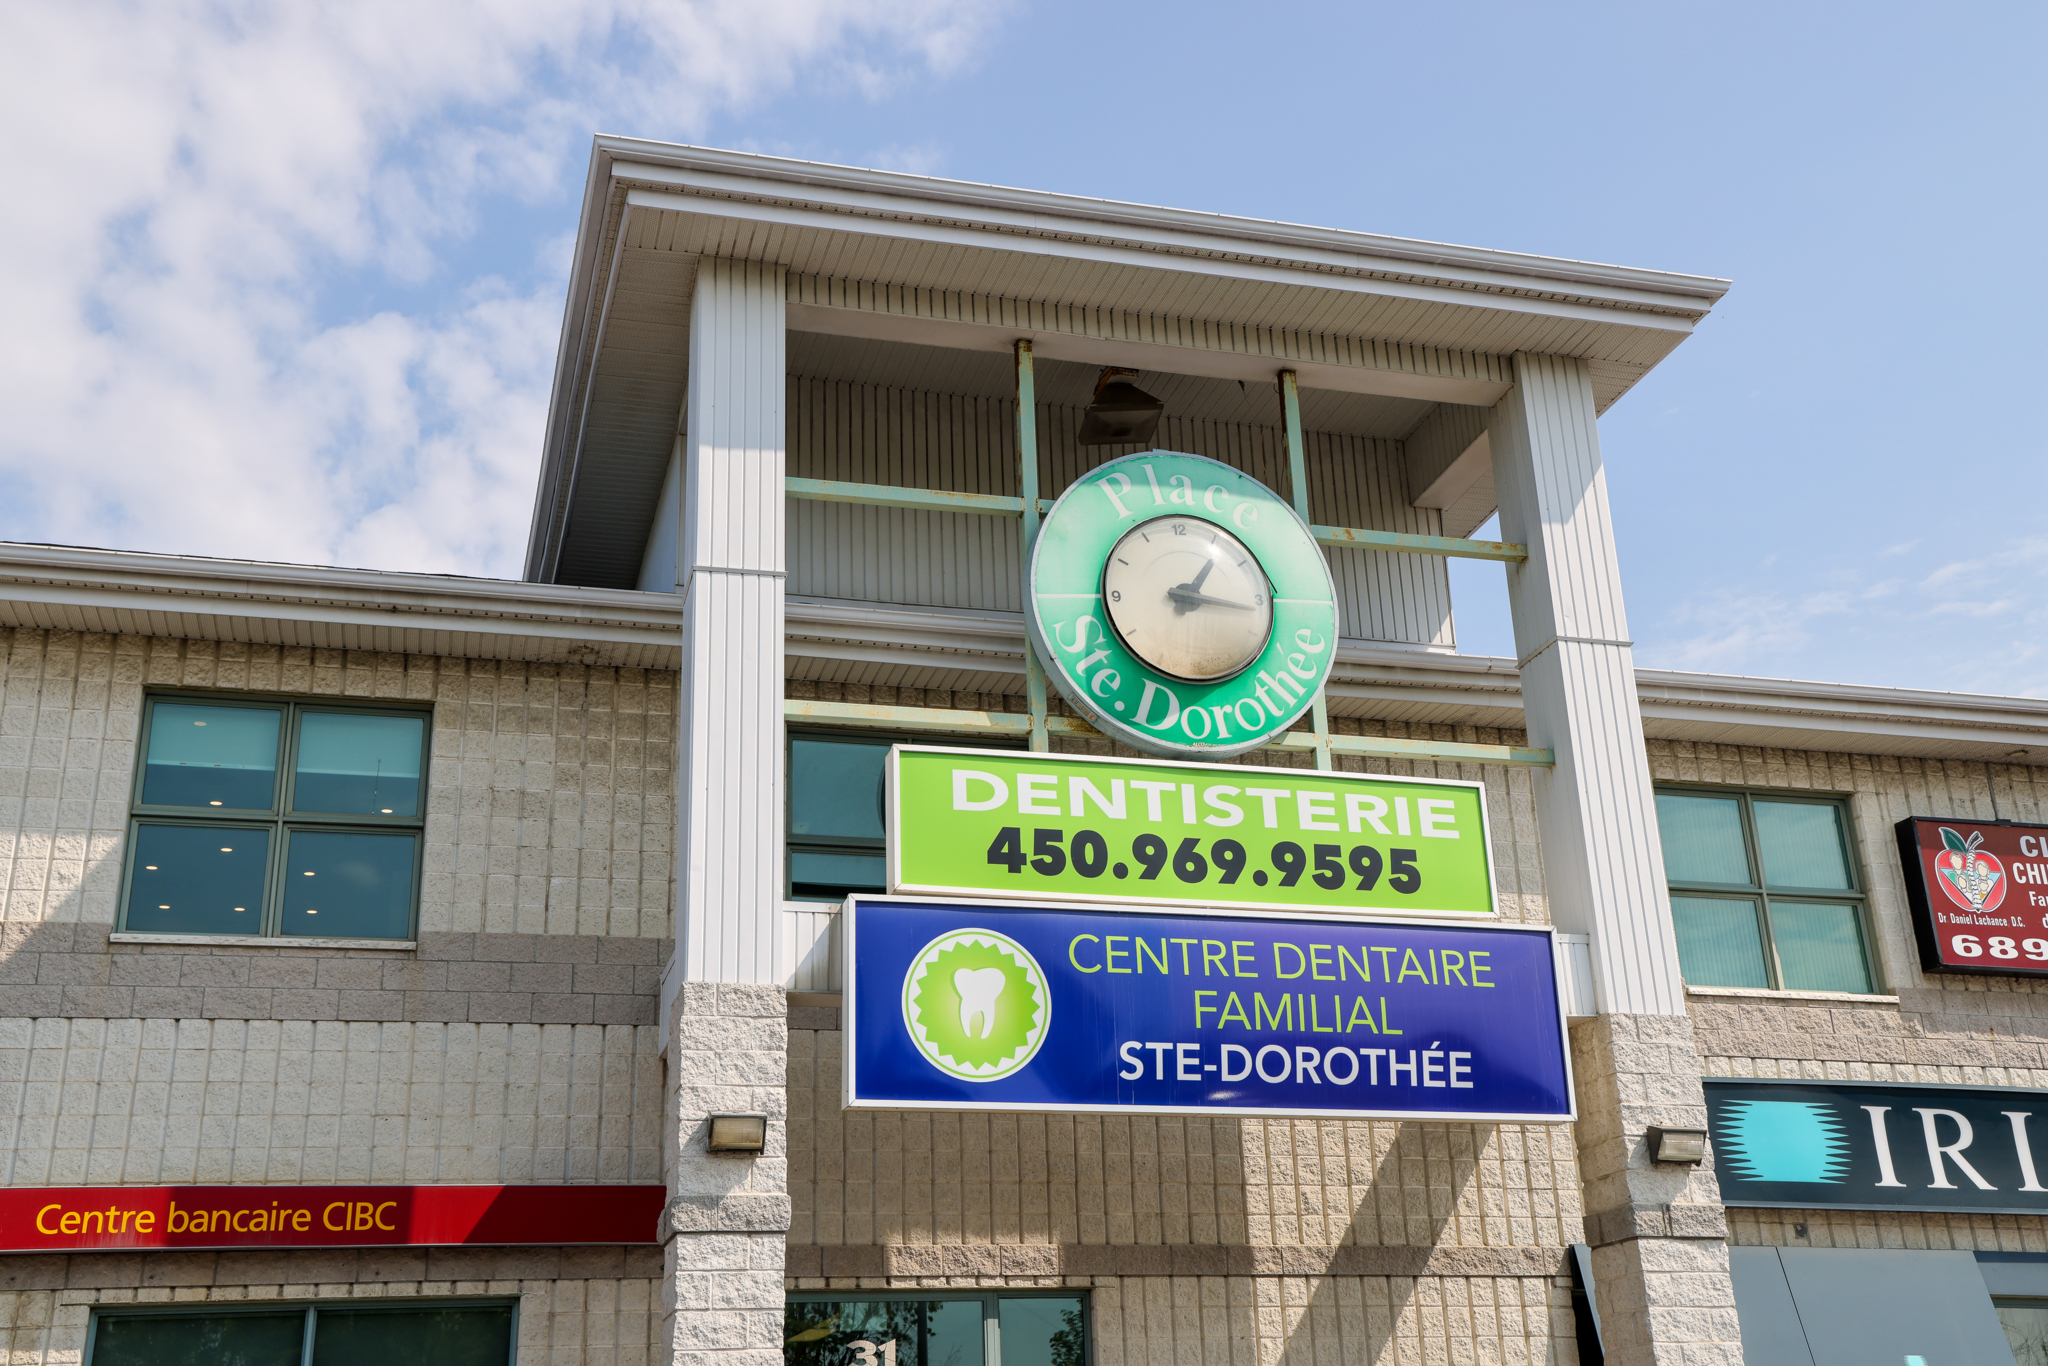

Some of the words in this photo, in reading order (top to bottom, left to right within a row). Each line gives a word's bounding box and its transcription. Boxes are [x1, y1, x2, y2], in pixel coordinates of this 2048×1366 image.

[1092, 463, 1259, 530] Place
[1170, 523, 1188, 536] 12
[1110, 590, 1122, 603] 9
[1253, 593, 1265, 606] 3
[951, 768, 1461, 840] DENTISTERIE
[987, 826, 1422, 895] 450.969.9595
[2012, 862, 2048, 885] CHI
[2028, 890, 2048, 907] Fa
[1949, 912, 1973, 925] Daniel
[1973, 914, 2008, 927] Lachance
[1068, 933, 1259, 979] CENTRE
[1272, 941, 1496, 988] DENTAIRE
[1951, 934, 2048, 961] 689
[1194, 989, 1404, 1036] FAMILIAL
[1119, 1040, 1474, 1089] STE-DOROTHÉE
[36, 1203, 156, 1235] Centre
[167, 1201, 311, 1233] bancaire
[323, 1201, 397, 1231] CIBC
